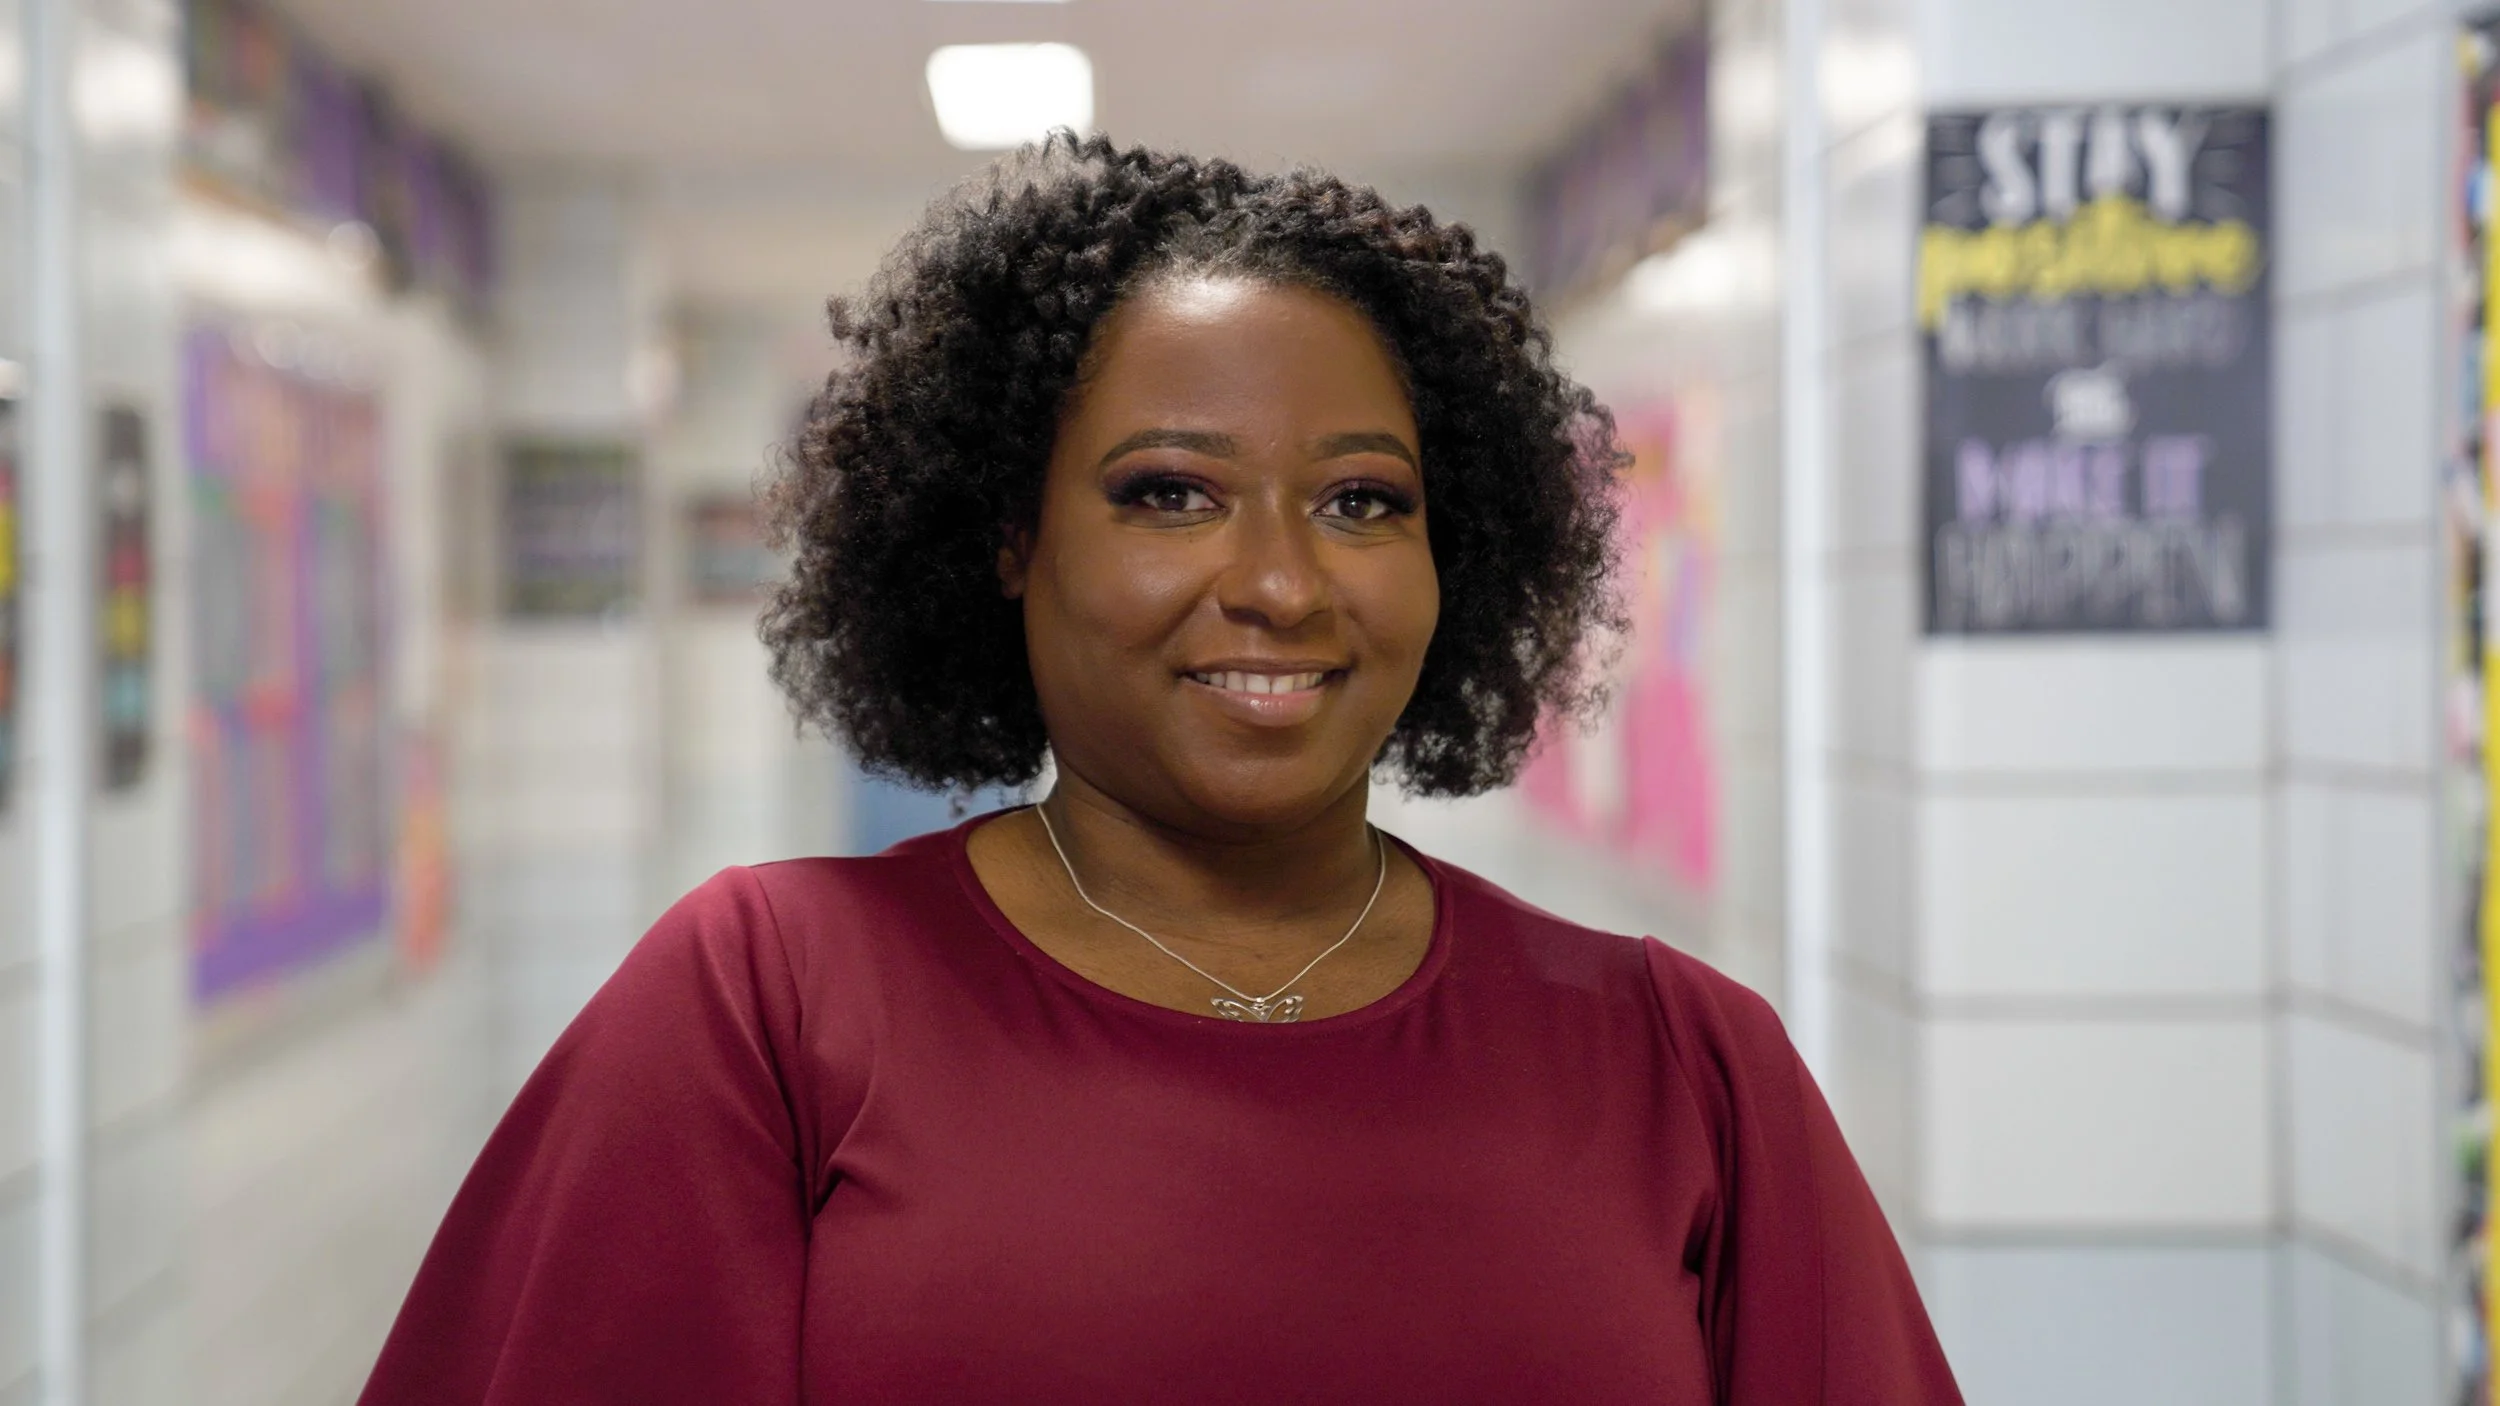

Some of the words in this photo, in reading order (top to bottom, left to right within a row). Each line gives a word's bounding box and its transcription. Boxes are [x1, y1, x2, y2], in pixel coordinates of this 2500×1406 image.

[1980, 110, 2208, 220] STAY
[1917, 198, 2256, 332] positive
[1956, 440, 2126, 526] MAKE
[2142, 436, 2212, 518] IT
[1935, 514, 2246, 626] HAPPEN
